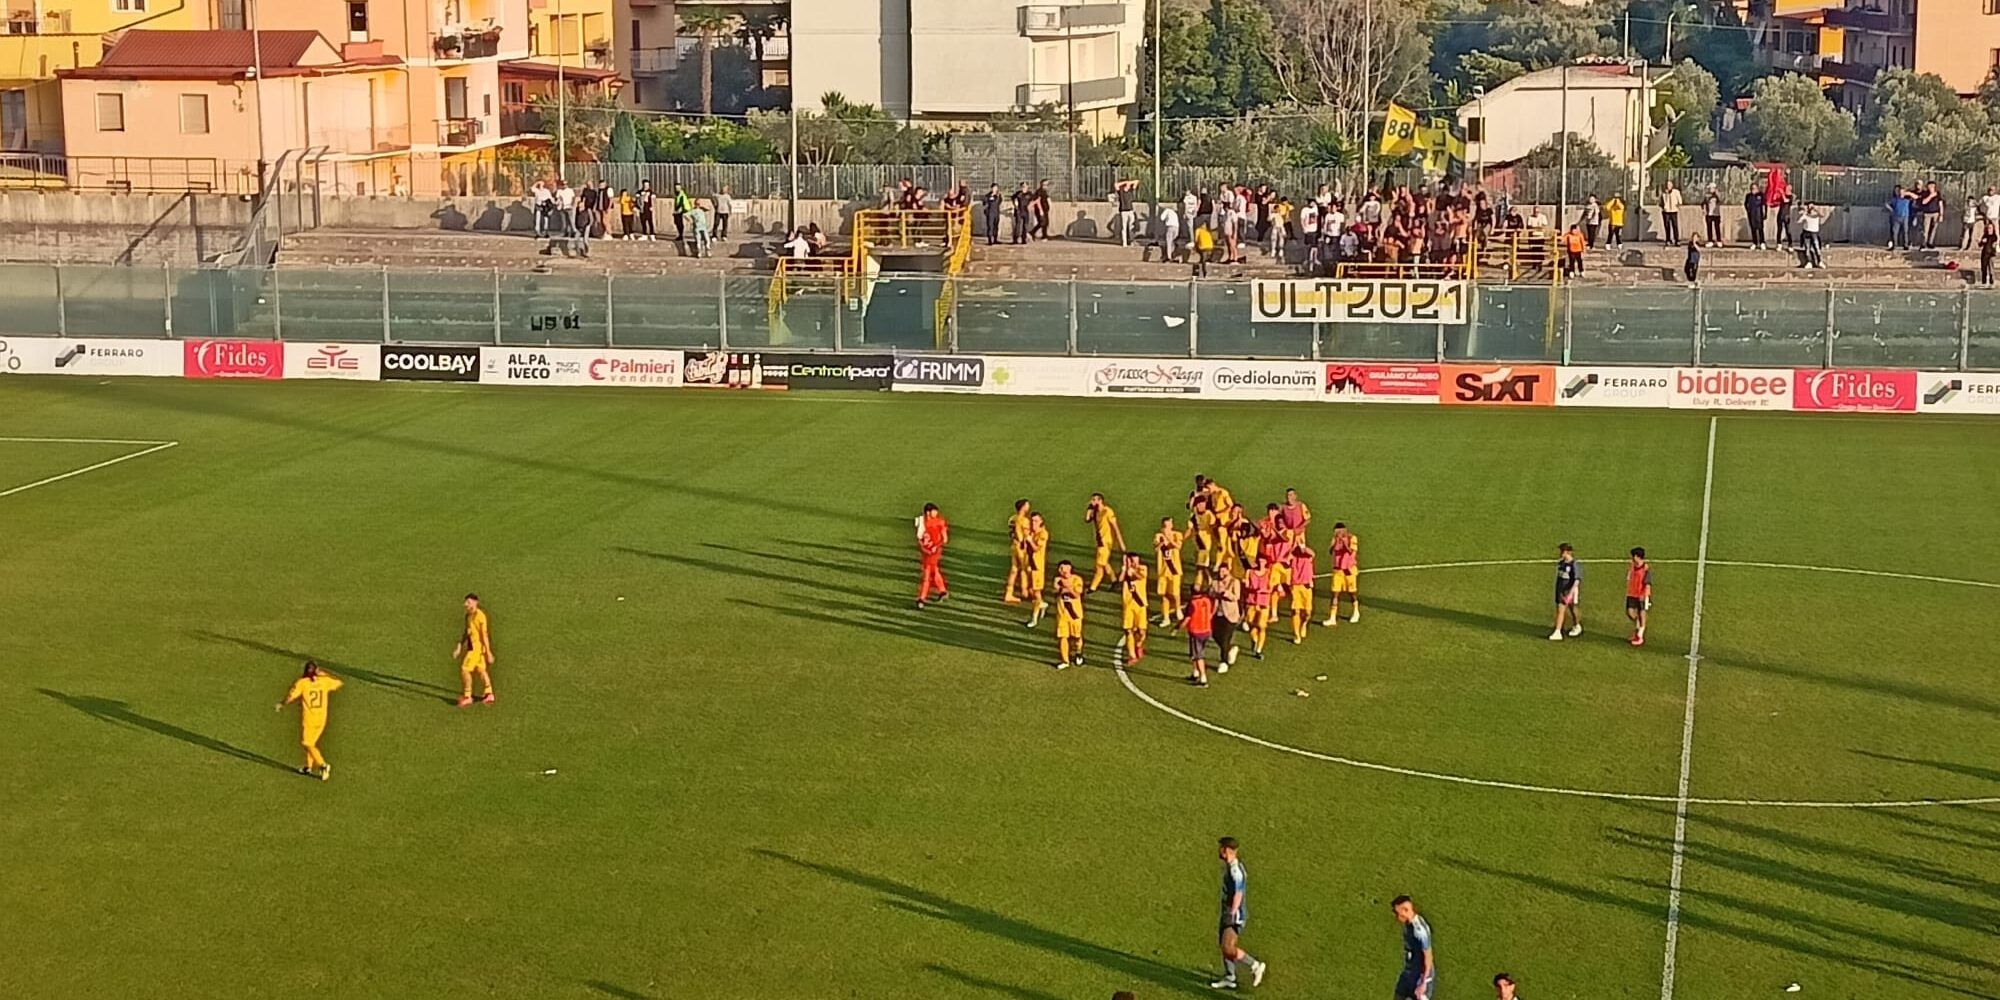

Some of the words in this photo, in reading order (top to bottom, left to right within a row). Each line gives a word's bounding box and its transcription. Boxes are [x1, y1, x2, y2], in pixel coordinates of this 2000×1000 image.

[1387, 119, 1411, 139] 88
[1257, 282, 1462, 320] ULT2021
[90, 348, 144, 357] FERRARO
[213, 343, 267, 367] Fides
[384, 353, 476, 374] COOLBAY
[508, 367, 550, 379] IVECO
[610, 359, 675, 374] Palmieri
[920, 361, 980, 382] FRIMM
[610, 374, 674, 384] vending
[1217, 370, 1317, 386] mediolanum
[1604, 378, 1668, 388] FERRARO
[1676, 370, 1787, 395] bidibee
[1831, 373, 1896, 399] Fides
[309, 690, 323, 708] 21
